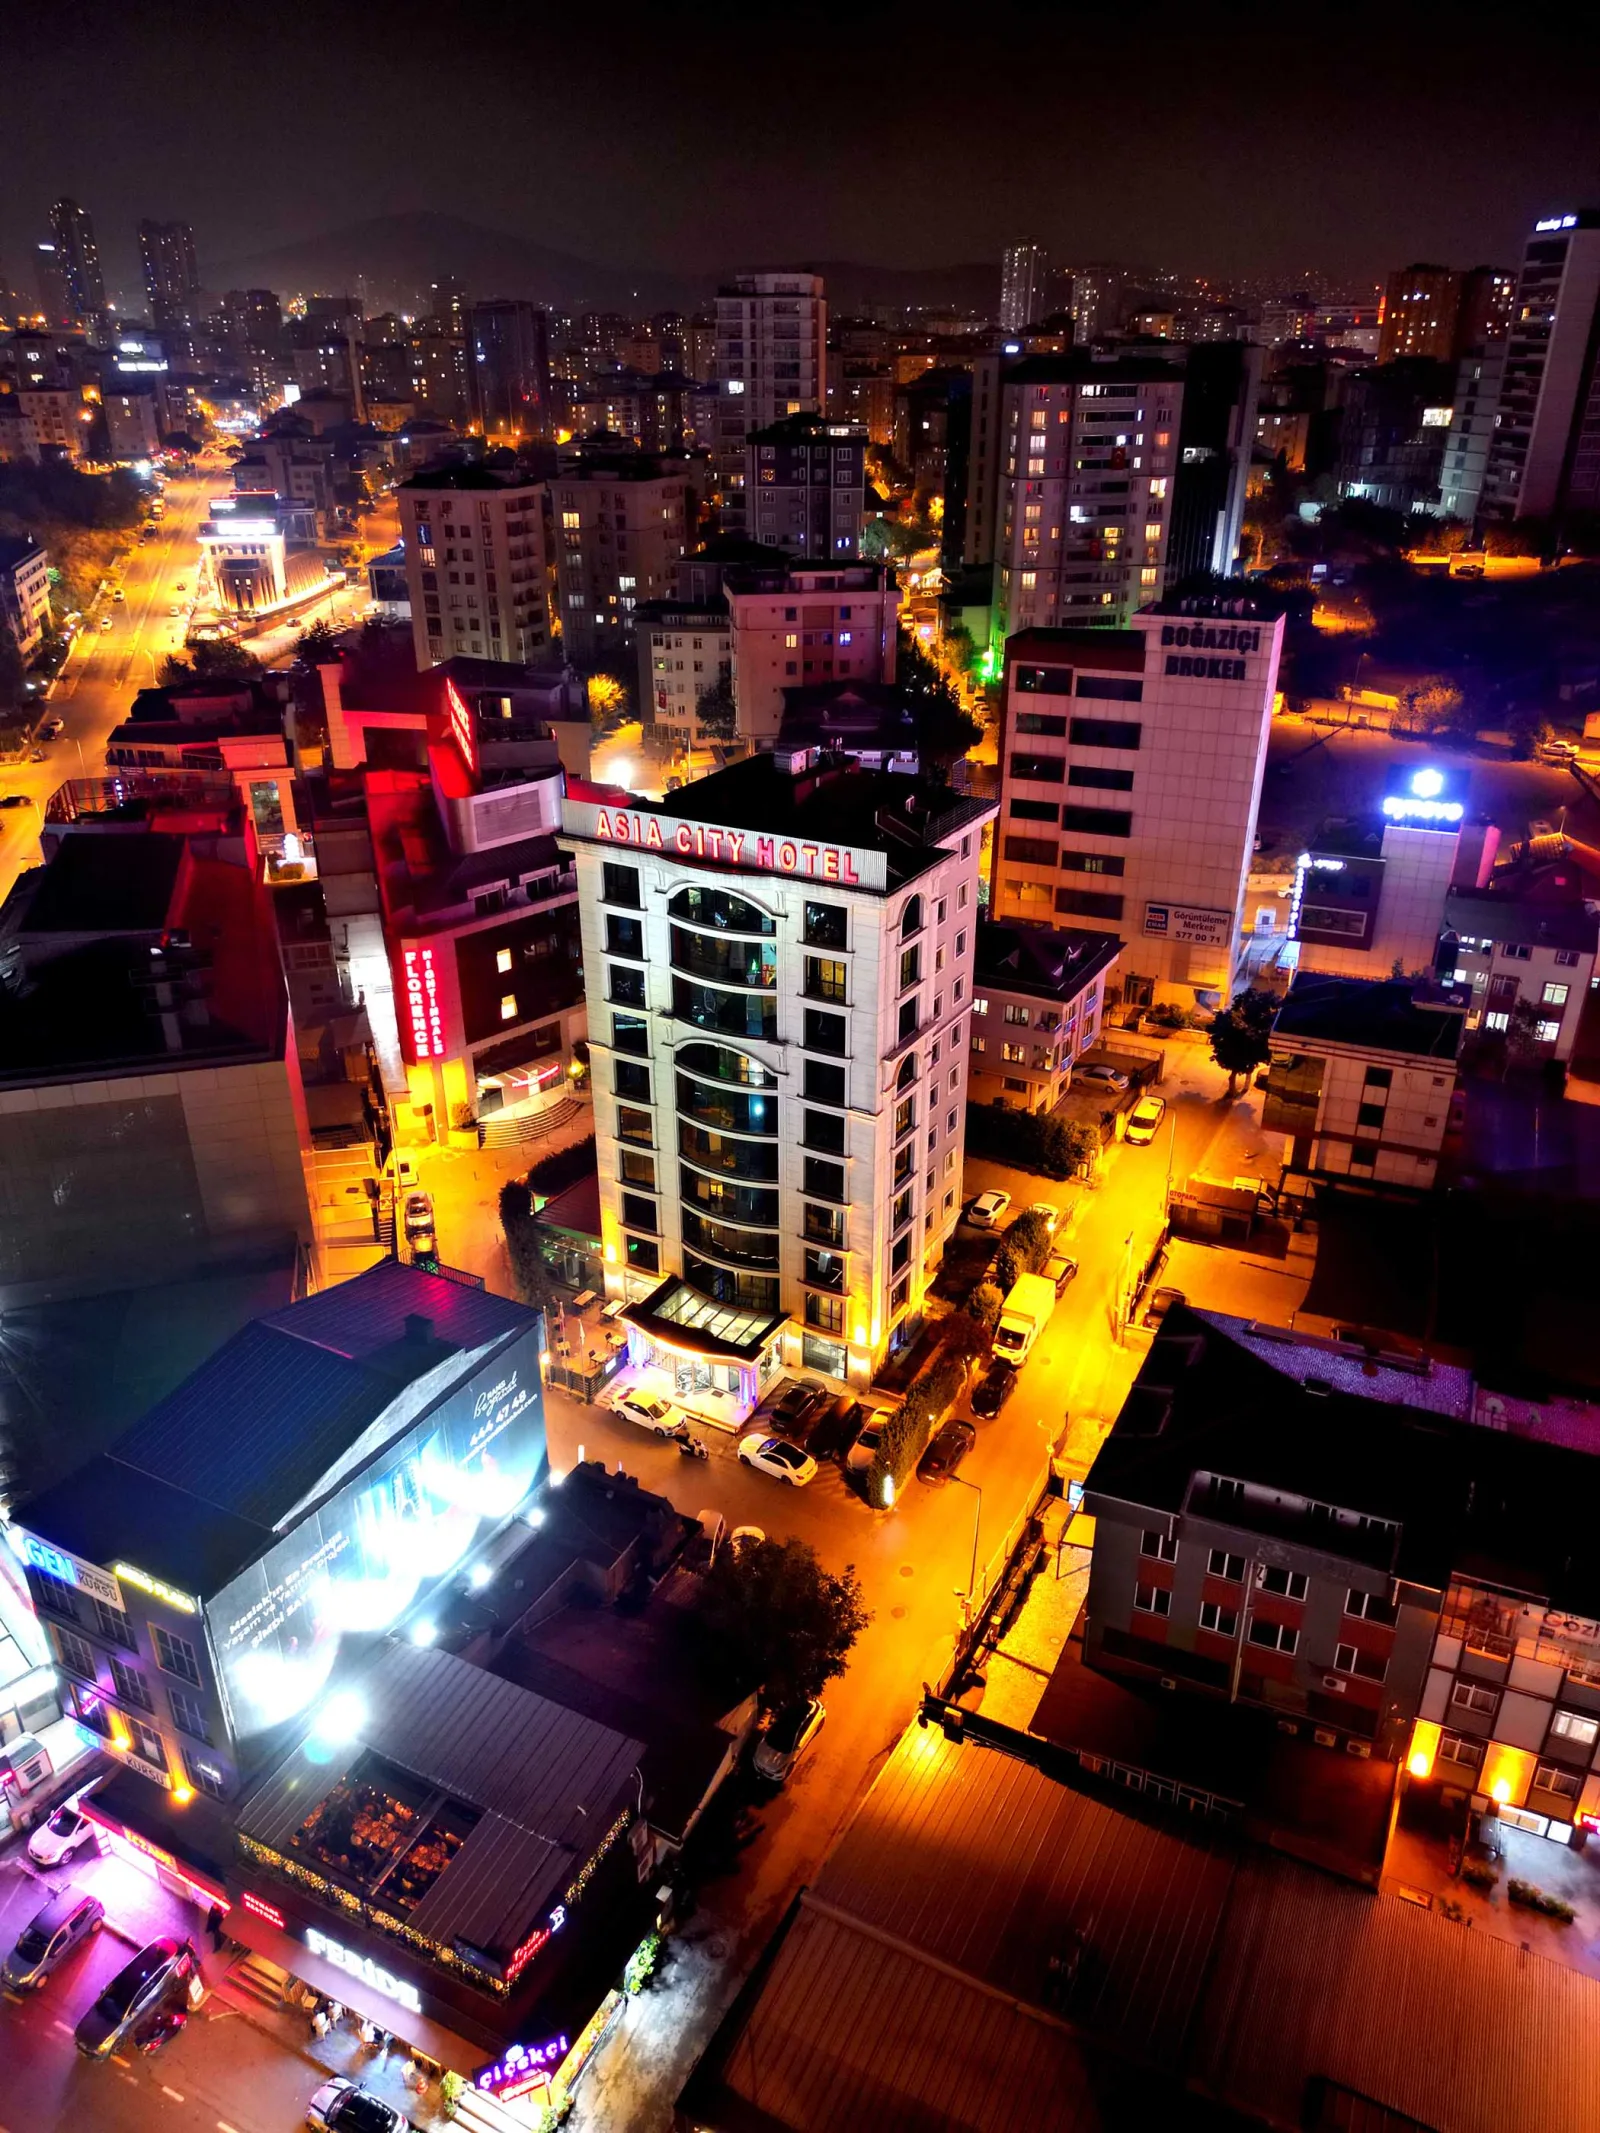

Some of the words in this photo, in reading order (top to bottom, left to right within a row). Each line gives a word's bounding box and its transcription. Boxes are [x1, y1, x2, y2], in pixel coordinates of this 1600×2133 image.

[1161, 622, 1261, 655] BOĞAZİÇİ
[1165, 655, 1246, 680] BROKER
[596, 808, 664, 848] ASIA
[676, 823, 745, 862] CITY
[756, 837, 859, 884] HOTEL
[1173, 910, 1227, 925] Görüntüleme
[1182, 920, 1216, 932] Merkezi
[1175, 930, 1192, 940] 577
[405, 951, 430, 1057] FLORENCE
[24, 1537, 77, 1585] GEN
[78, 1574, 118, 1602] KURSU
[127, 1755, 165, 1785] KURSU
